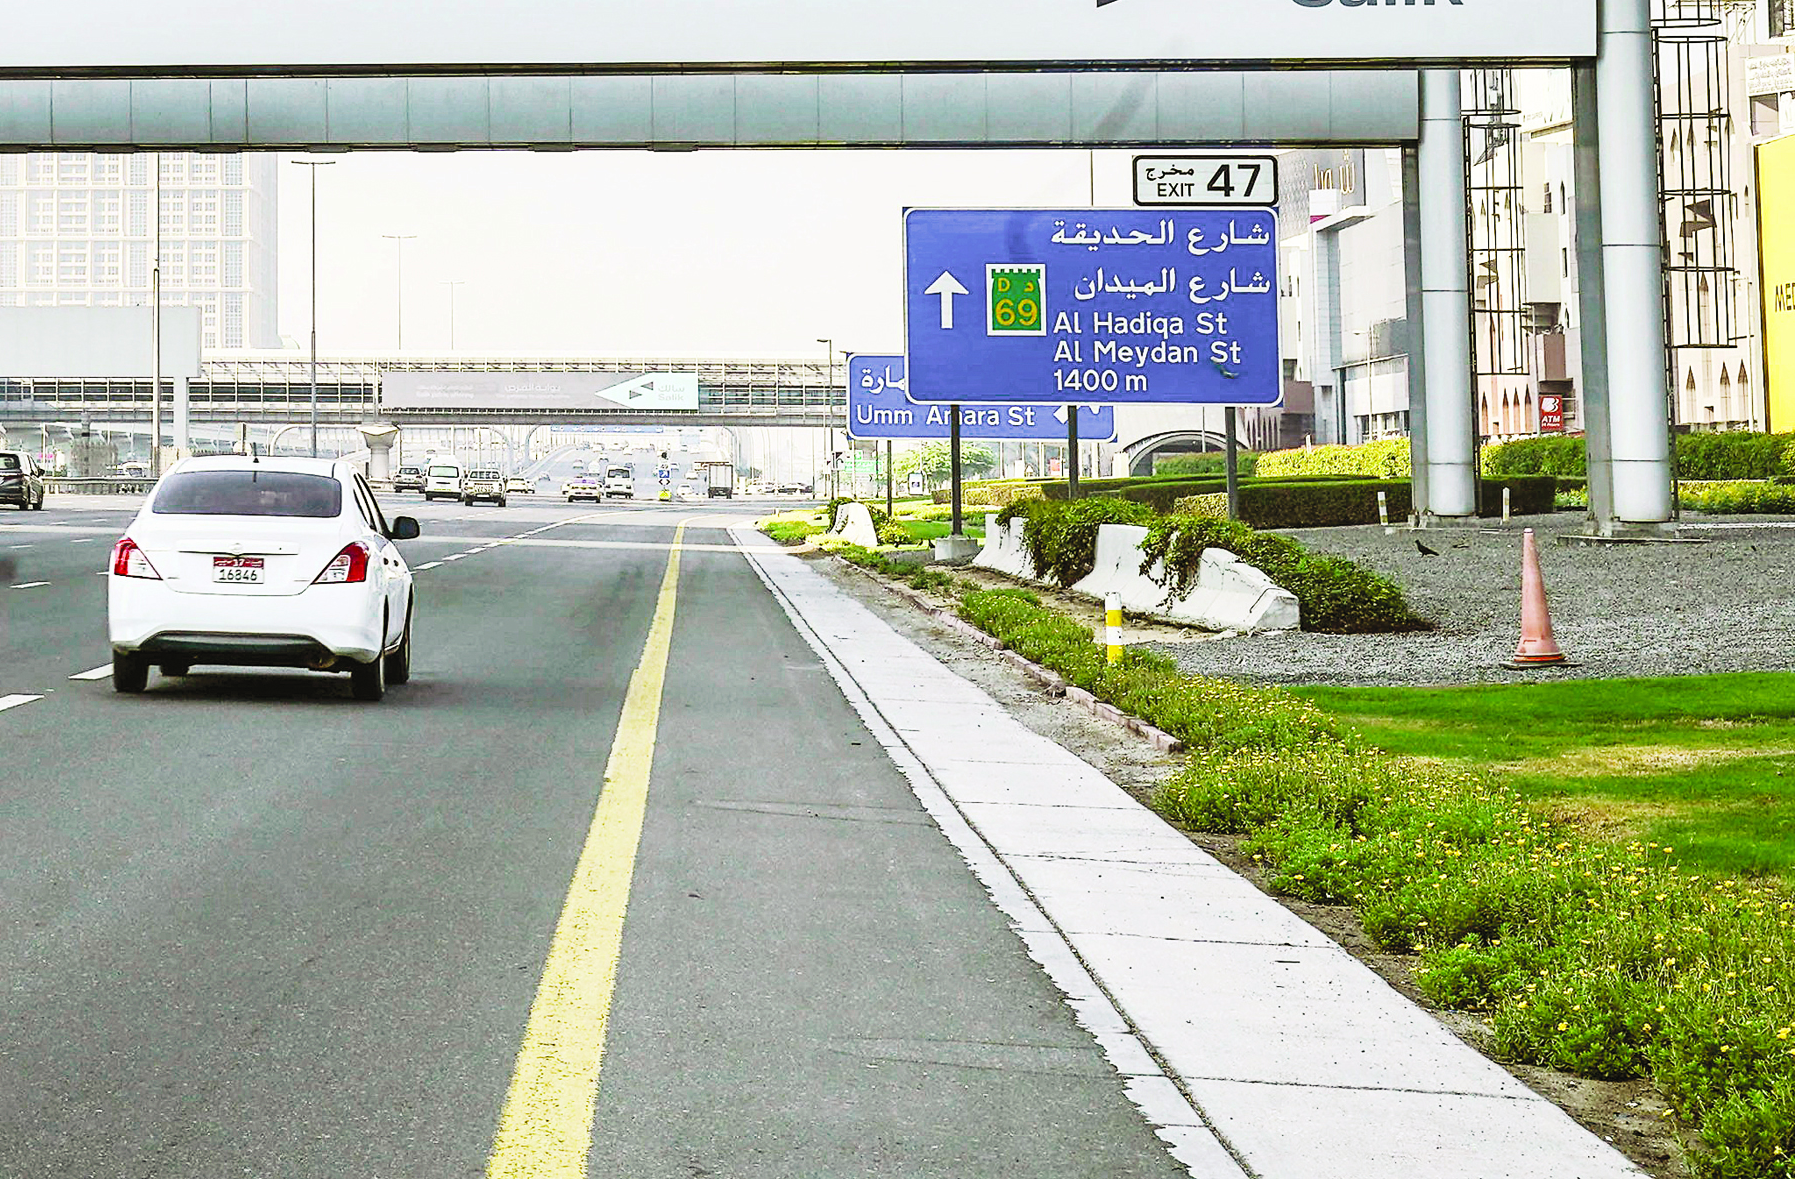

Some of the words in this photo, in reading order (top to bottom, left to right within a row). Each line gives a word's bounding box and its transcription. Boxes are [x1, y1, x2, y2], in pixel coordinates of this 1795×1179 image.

[1146, 164, 1195, 181] مخرج
[1207, 164, 1261, 197] 47
[1157, 183, 1195, 197] EXIT
[1051, 218, 1175, 252] الحديقة
[1187, 219, 1271, 256] شارع
[997, 277, 1011, 293] D
[1074, 267, 1176, 301] الميدان
[1188, 267, 1271, 304] شارع
[995, 299, 1038, 327] 69
[1053, 311, 1082, 334] Al
[1094, 311, 1184, 339] Hadiqa
[1196, 312, 1228, 335] St
[1053, 340, 1083, 363] Al
[1094, 340, 1198, 368] Meydan
[1210, 340, 1241, 363] St
[861, 365, 905, 394] مارة
[1054, 369, 1118, 391] 1400
[1125, 374, 1148, 391] m
[658, 393, 684, 401] Salik
[856, 404, 913, 424] Umm
[1008, 405, 1036, 426] St
